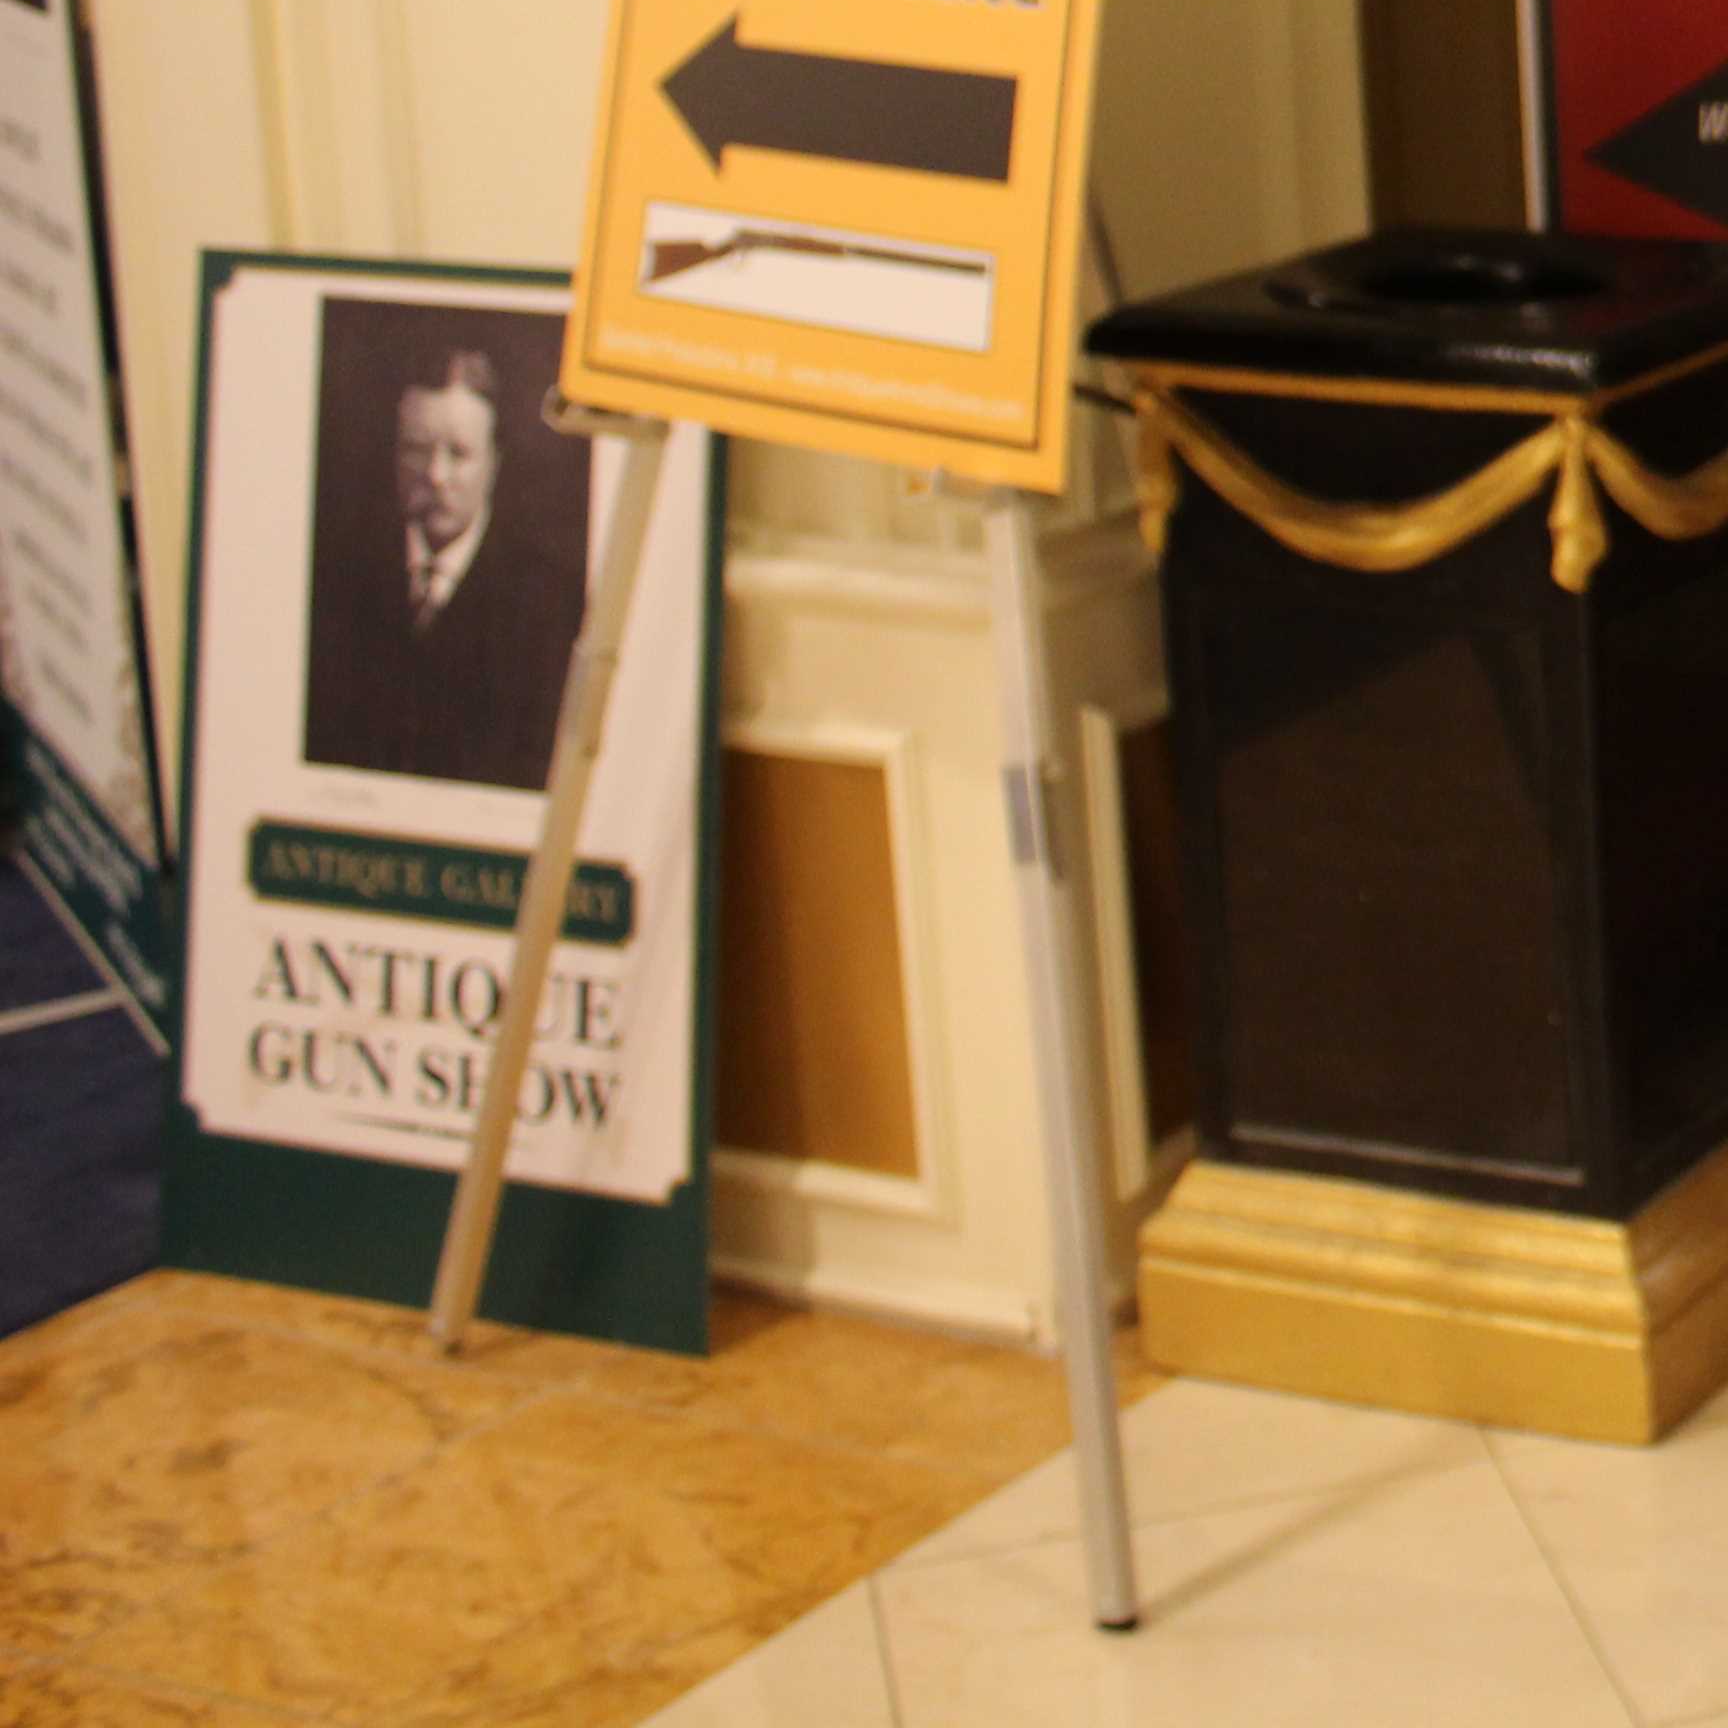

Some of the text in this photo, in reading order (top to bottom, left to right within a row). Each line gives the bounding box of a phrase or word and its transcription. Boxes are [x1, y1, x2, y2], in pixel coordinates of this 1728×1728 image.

[267, 840, 621, 919] ANTIQUE GALRY
[249, 1021, 398, 1097] GUN
